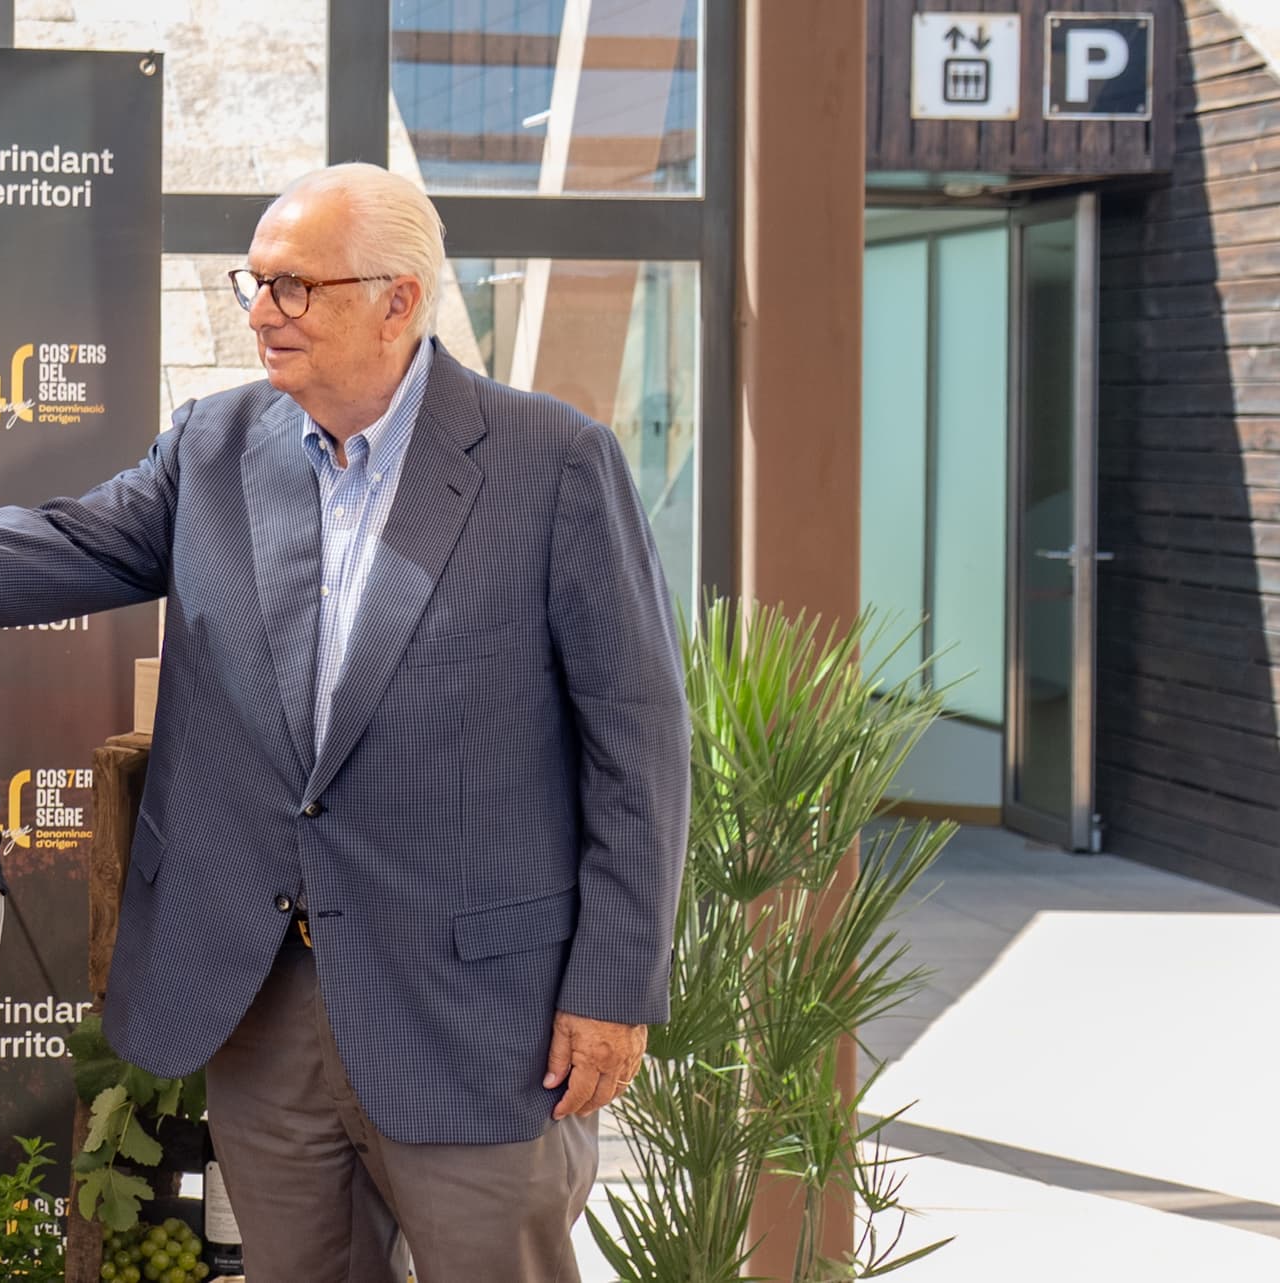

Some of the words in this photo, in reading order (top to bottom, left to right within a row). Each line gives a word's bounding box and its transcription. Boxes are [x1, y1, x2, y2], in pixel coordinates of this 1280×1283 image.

[1066, 29, 1129, 103] P
[39, 344, 107, 364] COS7ERS
[39, 364, 67, 382] DEL
[39, 382, 87, 401] SEGRE
[39, 404, 106, 413] Denominació
[36, 769, 93, 788] COS7ER
[36, 789, 64, 807] DEL
[36, 808, 83, 827] SEGRE
[36, 830, 93, 839] Denominac
[36, 839, 78, 850] d'Origen
